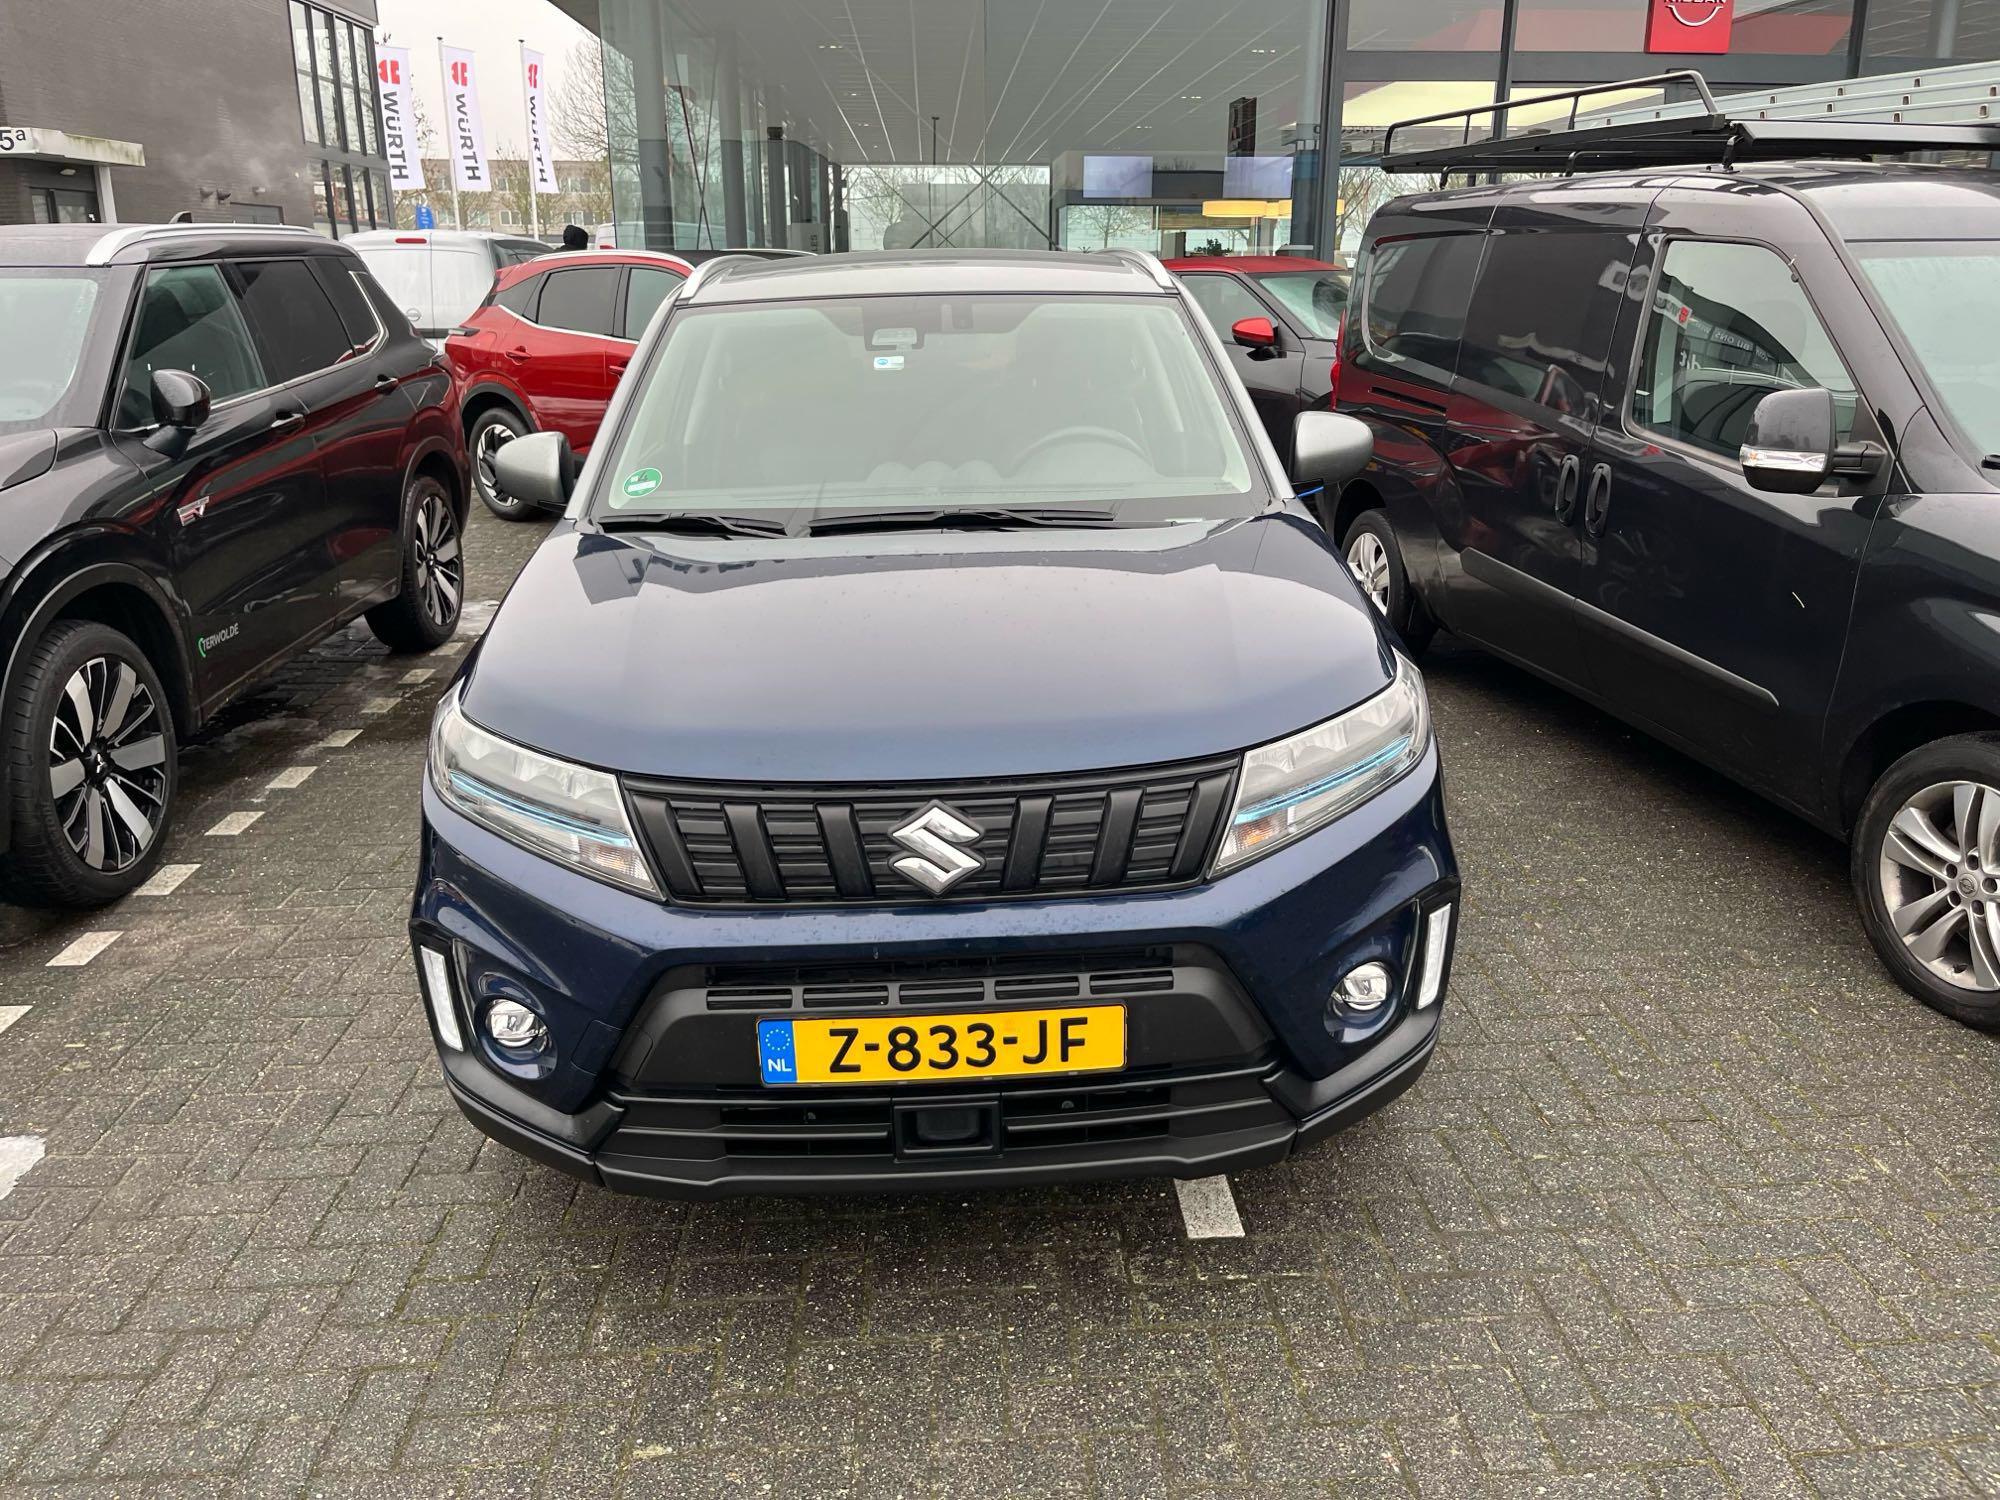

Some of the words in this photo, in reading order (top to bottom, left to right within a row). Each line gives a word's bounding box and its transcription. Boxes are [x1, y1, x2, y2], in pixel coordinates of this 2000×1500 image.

[382, 91, 410, 180] WÜRTH
[455, 93, 482, 181] WÜRTH
[529, 95, 548, 183] WÜRTH
[201, 622, 240, 652] TERWOLDE
[767, 1058, 793, 1073] NL
[828, 1016, 1089, 1074] Z-833-JF
